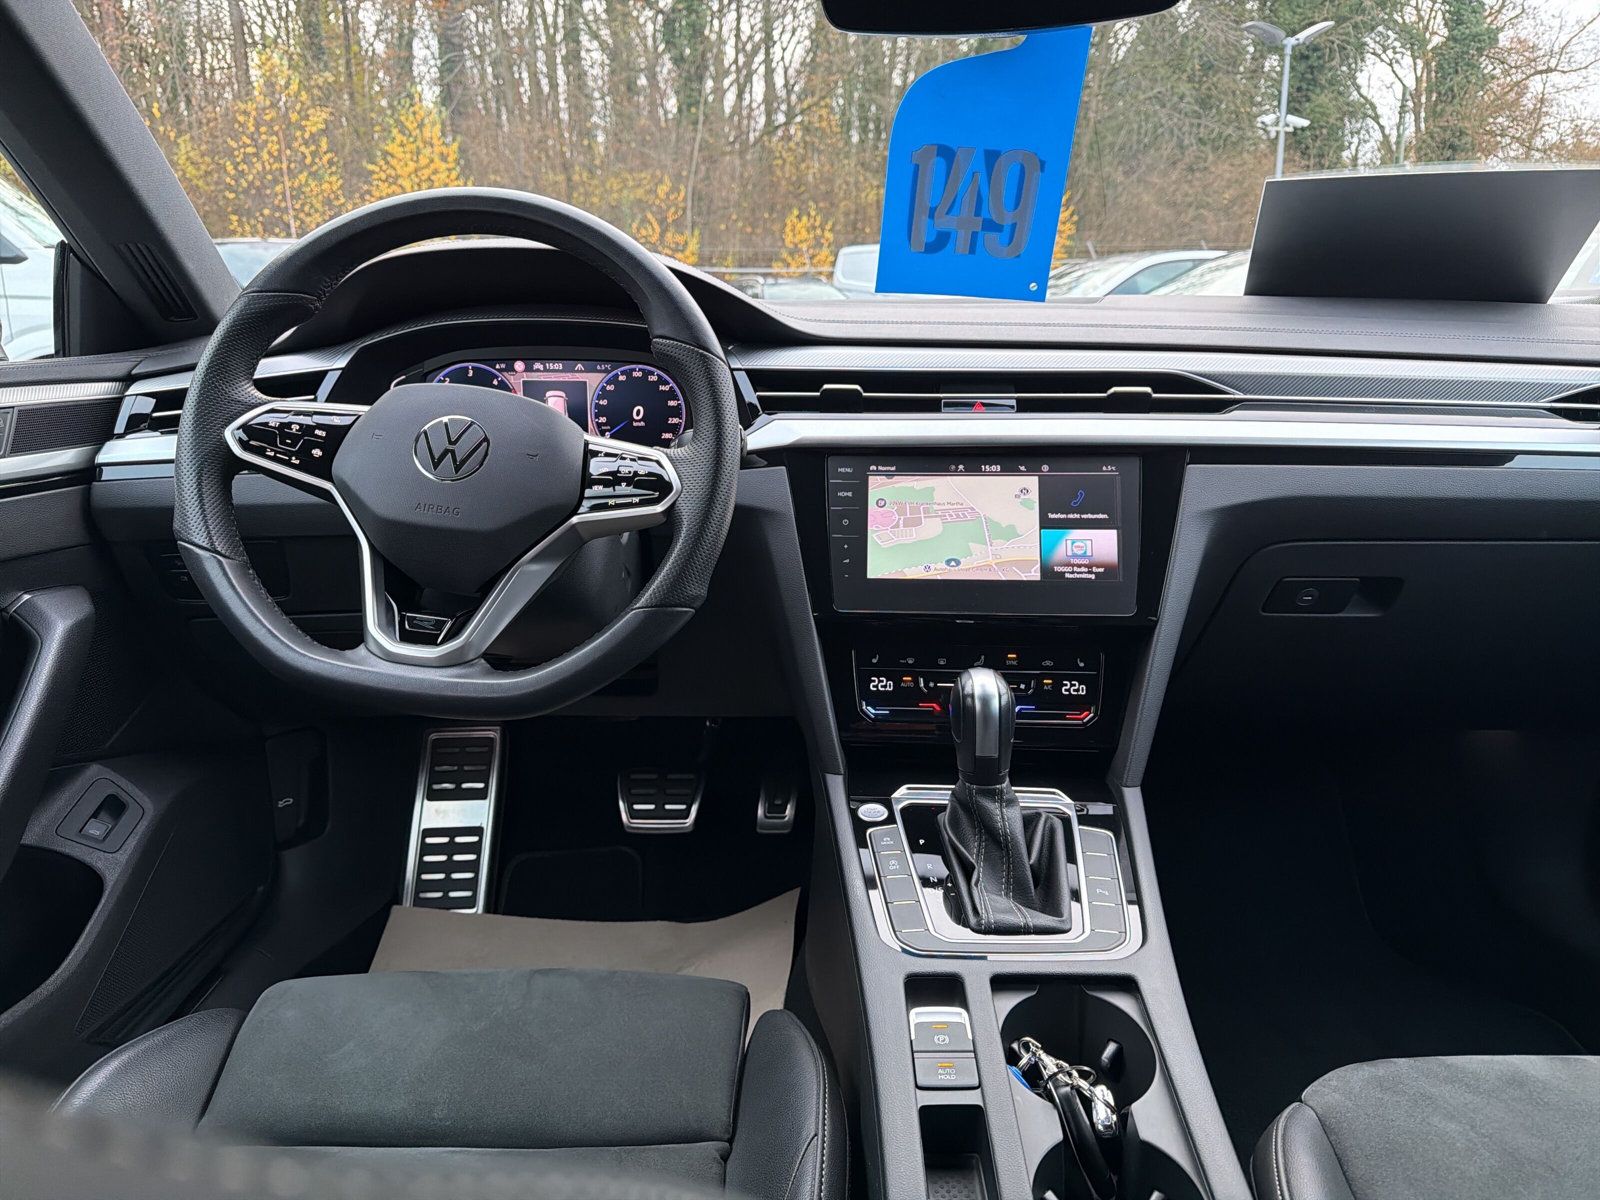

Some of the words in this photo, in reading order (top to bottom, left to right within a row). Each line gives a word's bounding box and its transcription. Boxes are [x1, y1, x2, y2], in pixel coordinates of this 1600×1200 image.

[910, 144, 1041, 259] 149
[467, 369, 473, 377] 3
[632, 406, 644, 420] 0
[314, 429, 327, 437] RES
[415, 502, 461, 517] AIRBAG
[870, 677, 893, 691] 22.0
[1062, 681, 1086, 695] 22.0
